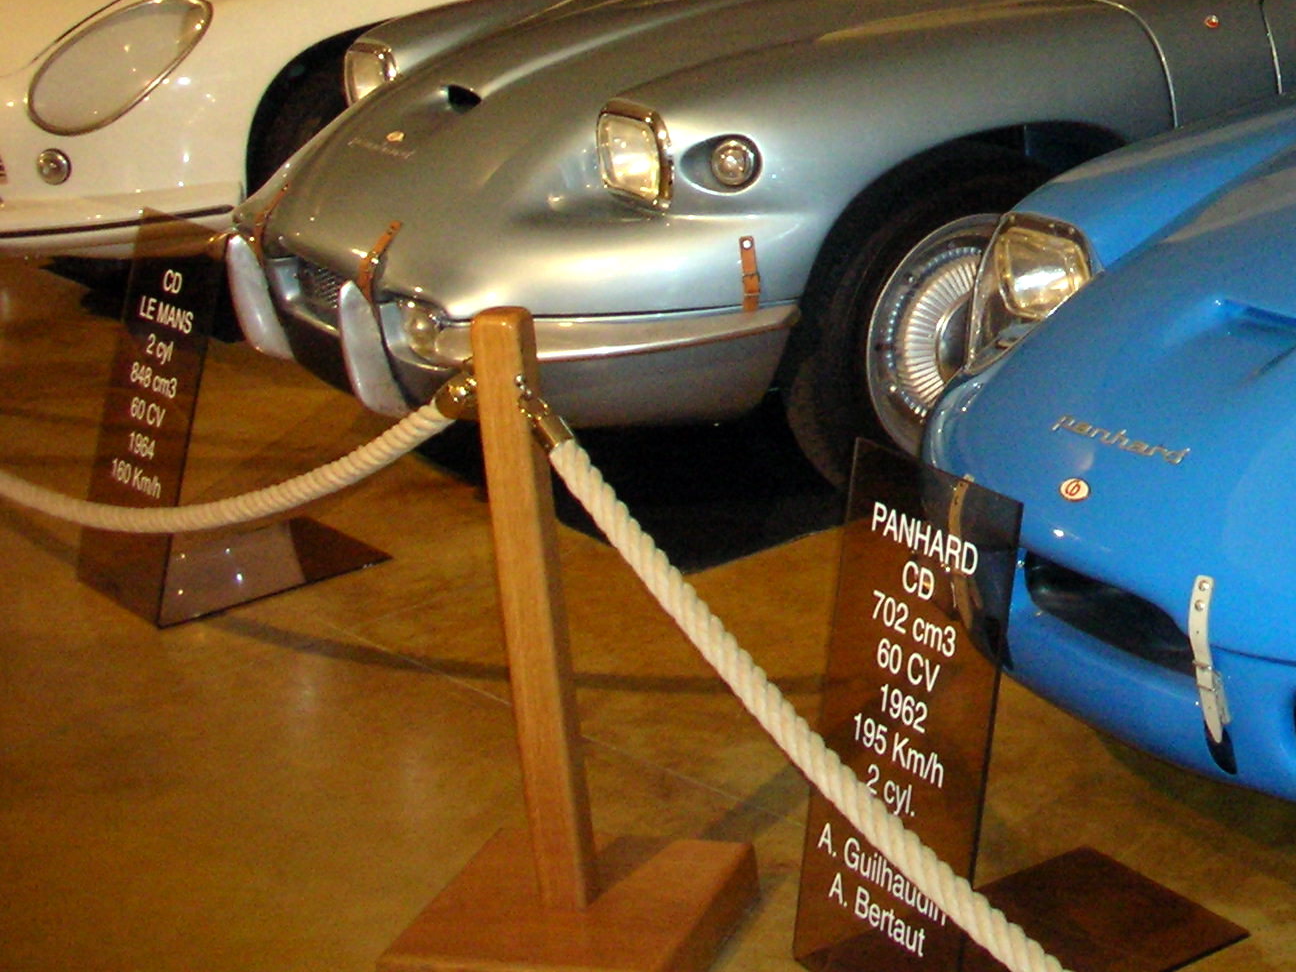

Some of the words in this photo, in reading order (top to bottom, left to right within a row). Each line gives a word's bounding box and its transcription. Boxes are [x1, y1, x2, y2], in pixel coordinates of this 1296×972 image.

[163, 269, 182, 294] CD
[139, 296, 155, 320] LE
[156, 304, 194, 335] MANS
[146, 333, 157, 355] 2
[157, 340, 173, 366] cyl
[152, 375, 178, 400] cm3
[130, 396, 145, 422] 60
[146, 402, 166, 428] CV
[128, 431, 155, 460] 1964
[111, 458, 131, 485] 160
[132, 466, 161, 500] Km/h
[871, 502, 979, 575] PANHARD
[902, 560, 935, 600] CD
[872, 590, 909, 634] 702
[912, 617, 956, 657] cm3
[877, 638, 902, 674] 60
[907, 653, 940, 693] CV
[880, 684, 928, 734] 1962
[854, 713, 887, 755] 195
[892, 732, 944, 788] Km/h
[866, 764, 880, 795] 2
[884, 780, 915, 817] cyl.
[817, 823, 836, 857] A.
[829, 872, 848, 908] A.
[855, 886, 926, 958] Bertaut
